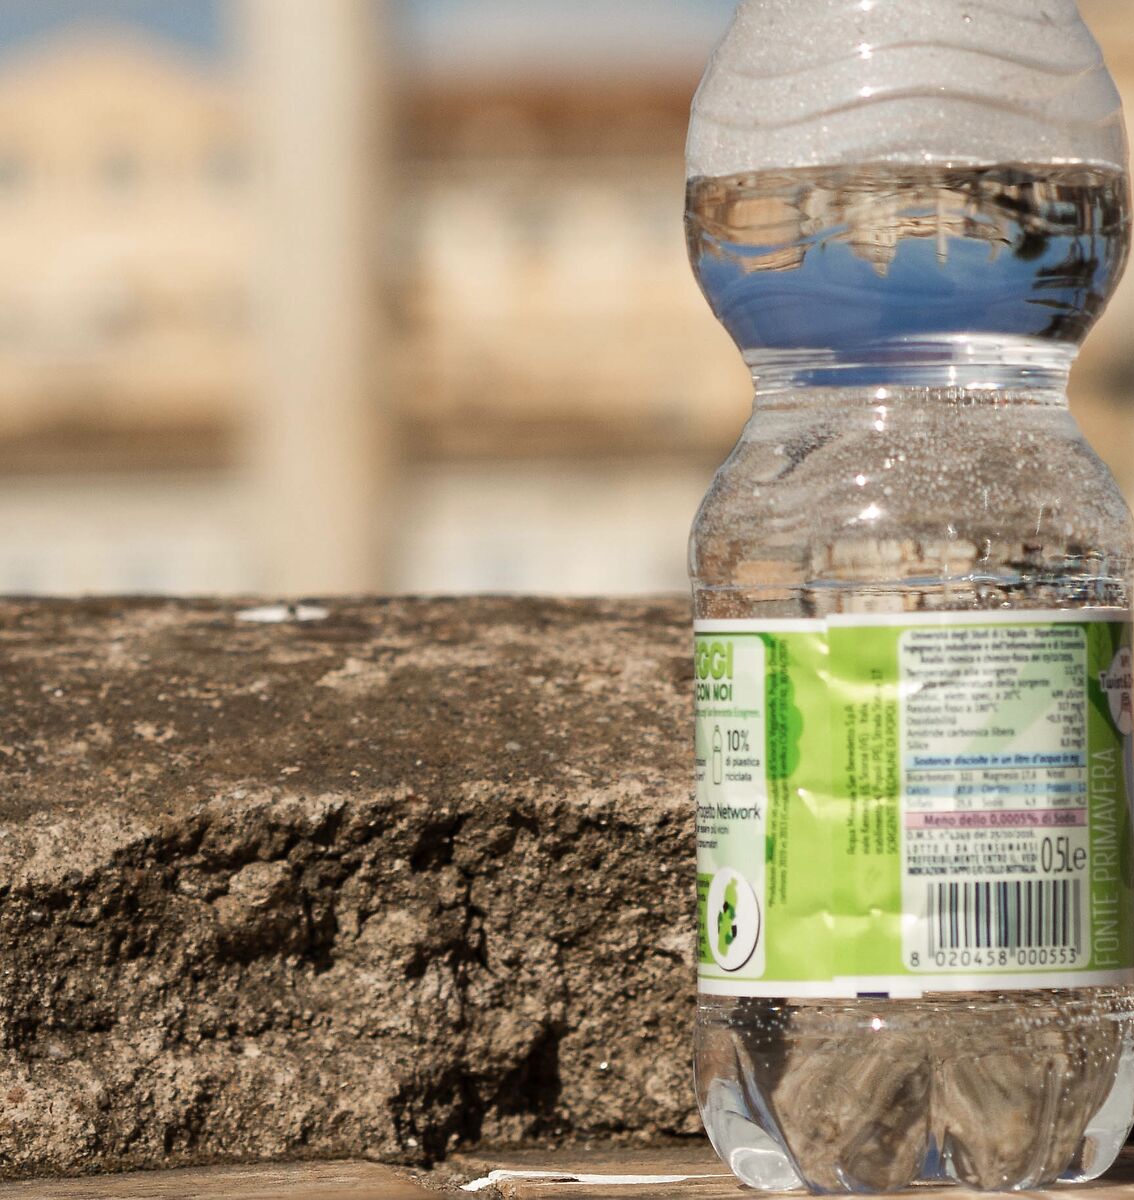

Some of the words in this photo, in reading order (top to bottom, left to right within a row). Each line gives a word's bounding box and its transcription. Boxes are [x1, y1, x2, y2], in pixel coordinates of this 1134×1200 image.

[714, 683, 732, 701] NOI
[727, 729, 750, 752] 10%
[717, 802, 760, 820] Network
[924, 814, 956, 826] Meno
[959, 813, 987, 825] dello
[1042, 811, 1052, 824] di
[1054, 811, 1077, 824] Sodio
[1092, 748, 1118, 881] PRIMAVERA
[1094, 892, 1119, 966] FONTE
[910, 952, 920, 967] 8
[935, 951, 1007, 967] 020458
[1017, 948, 1077, 965] 000553
